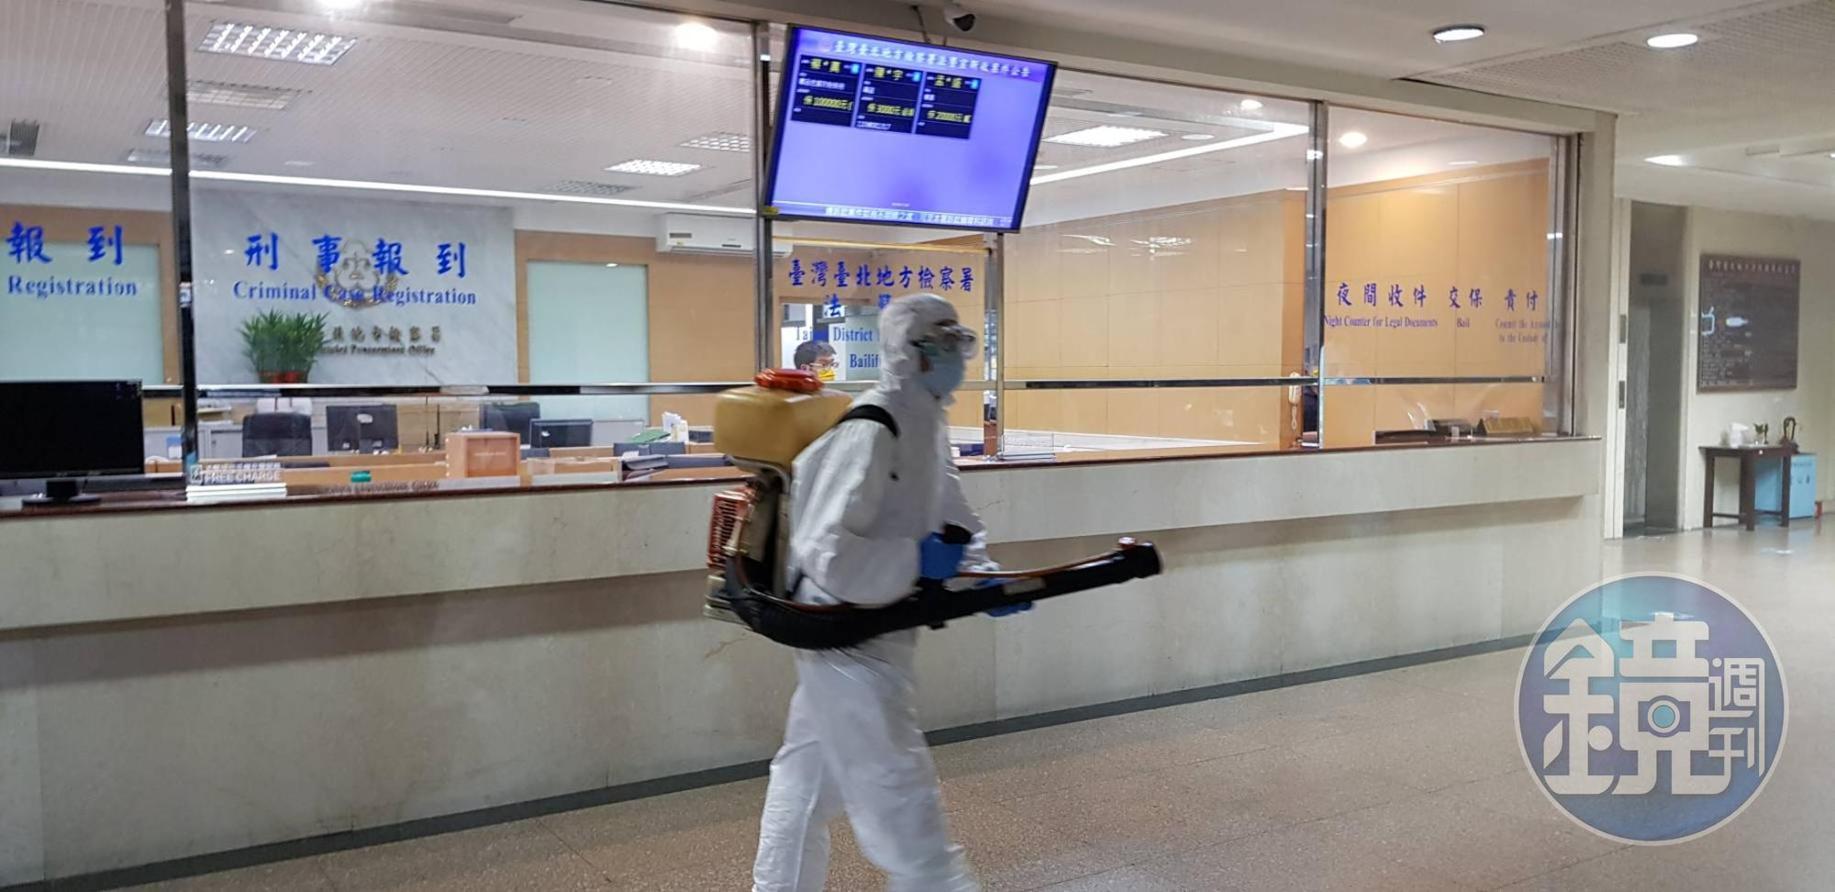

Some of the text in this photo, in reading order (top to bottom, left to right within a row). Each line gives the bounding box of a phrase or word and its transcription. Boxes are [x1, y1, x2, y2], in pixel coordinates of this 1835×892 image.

[6, 221, 123, 265] 報到
[245, 232, 466, 279] 刑事報到
[8, 275, 137, 299] Registration
[789, 259, 974, 292] 臺灣臺北地方檢察署
[233, 280, 476, 306] Criminal Case Registration
[1337, 282, 1428, 307] 夜間收件
[1449, 286, 1483, 308] 交保
[833, 327, 873, 342] District
[1385, 316, 1403, 328] Legal
